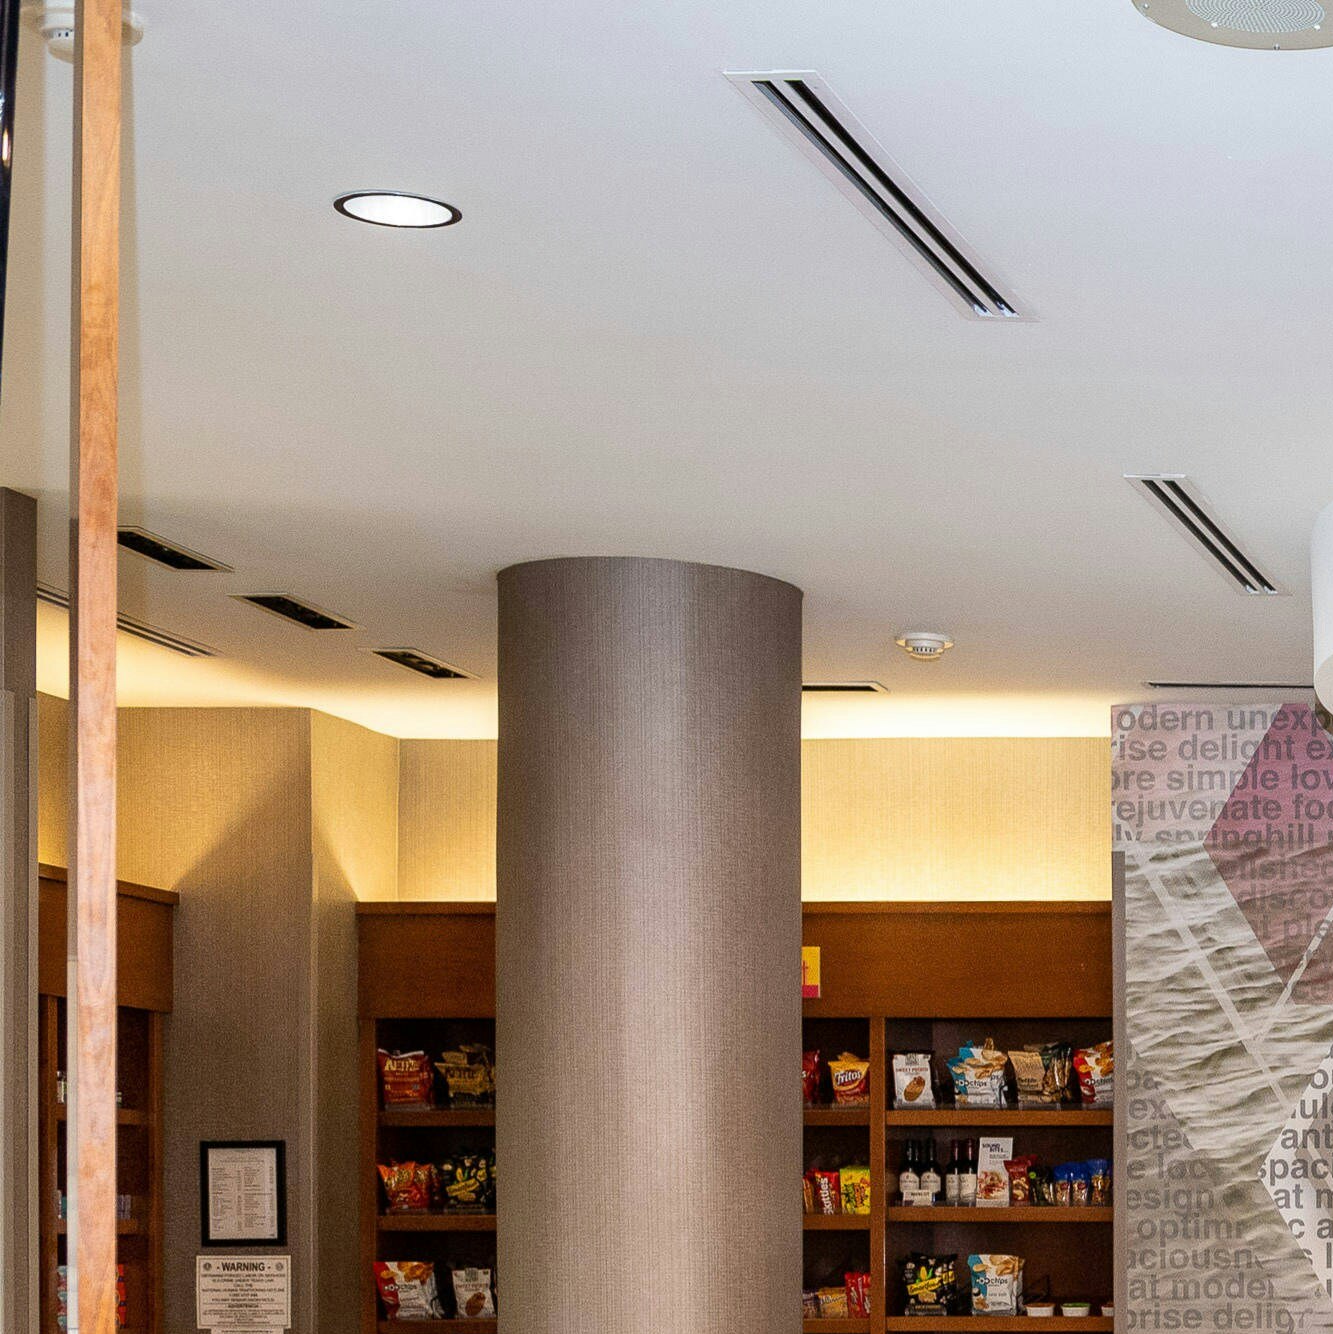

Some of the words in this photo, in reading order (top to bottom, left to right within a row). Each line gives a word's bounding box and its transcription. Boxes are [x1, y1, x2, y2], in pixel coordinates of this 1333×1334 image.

[1178, 735, 1296, 768] delight
[1166, 765, 1279, 798] simple
[1111, 795, 1283, 828] ejuvenate
[836, 1070, 863, 1085] Fritos
[221, 1262, 265, 1272] WARNING
